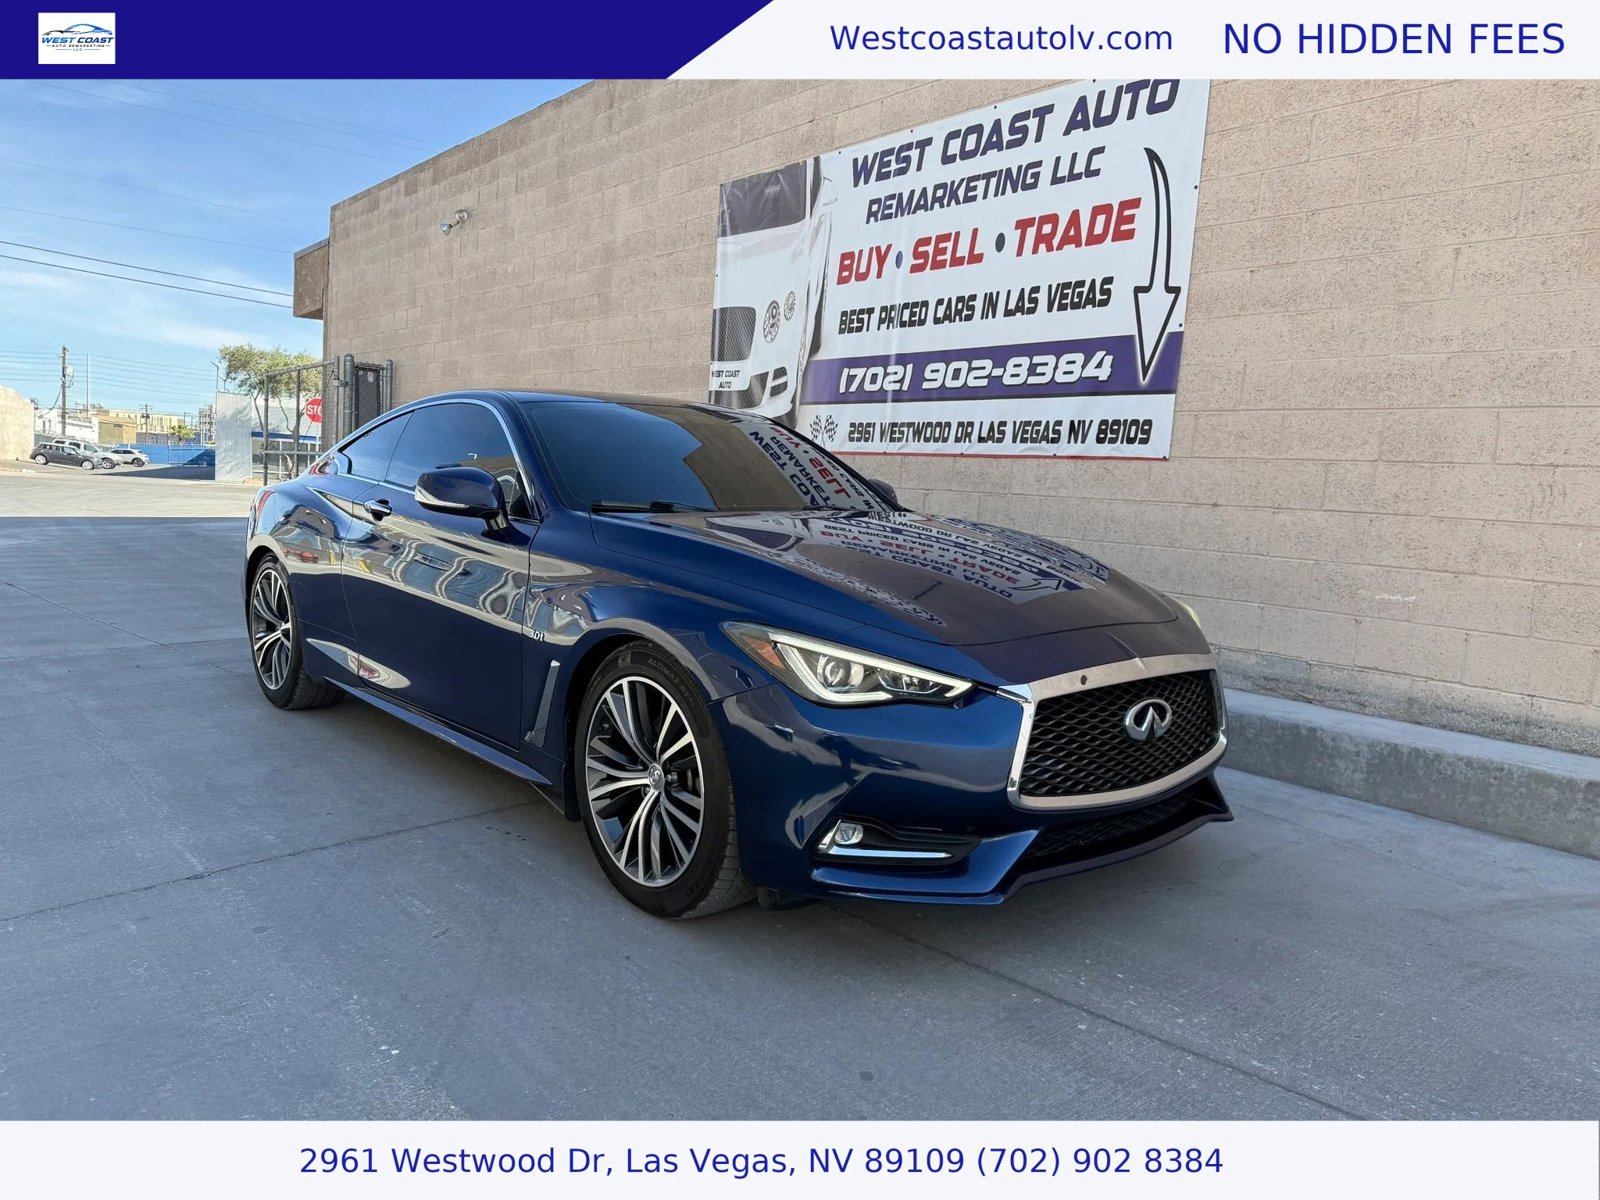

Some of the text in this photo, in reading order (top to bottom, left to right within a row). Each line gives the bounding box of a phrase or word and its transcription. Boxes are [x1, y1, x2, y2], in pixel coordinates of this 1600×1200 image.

[852, 79, 1180, 188] WEST COAST AUTO
[865, 146, 1106, 225] REMARKETING LLC
[836, 197, 1142, 286] BUY SELL TRADE
[838, 276, 1114, 335] BEST PRICED CARS IN LAS VEGAS
[719, 381, 731, 389] AUTO
[839, 350, 1114, 394] (702) 902-8384
[306, 405, 322, 415] STO
[848, 419, 1153, 445] 2961 WESTWOOD DR LAS VEGAS NV 89109
